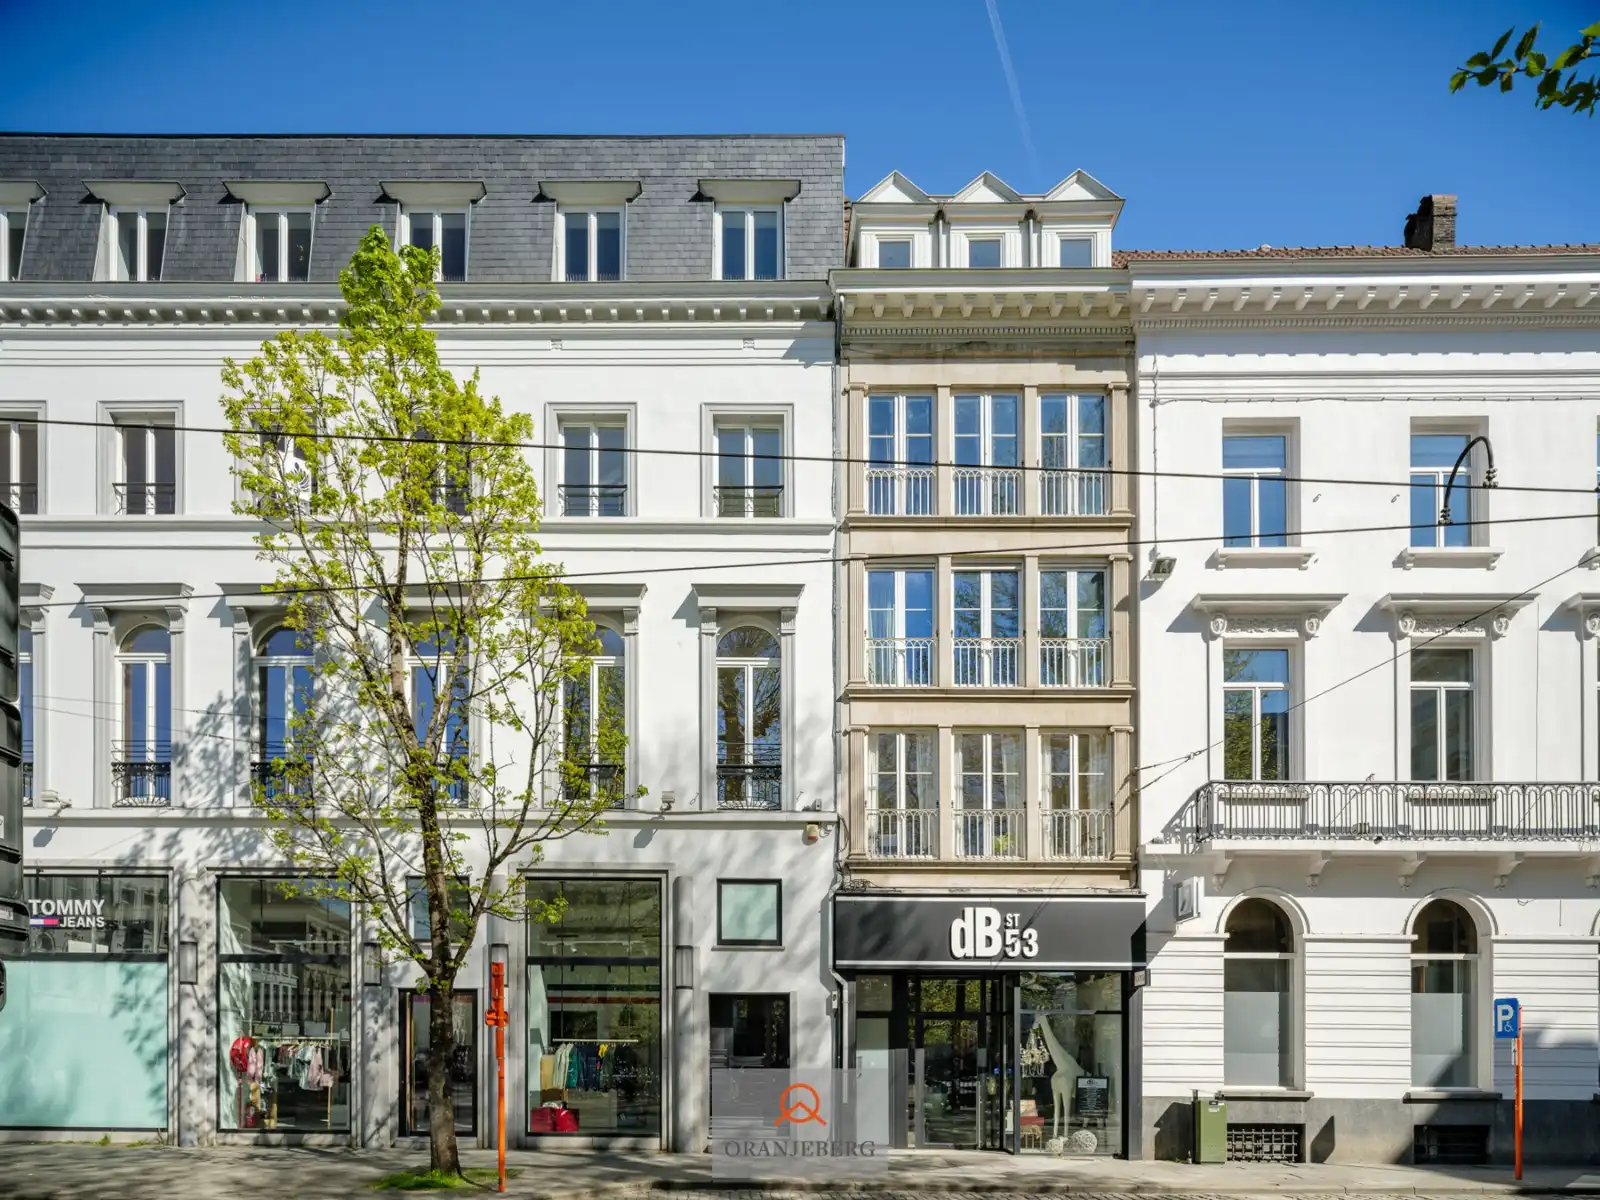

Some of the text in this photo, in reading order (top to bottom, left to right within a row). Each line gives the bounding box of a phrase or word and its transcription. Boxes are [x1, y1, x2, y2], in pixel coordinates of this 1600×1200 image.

[28, 899, 105, 916] TOMMY
[60, 916, 105, 928] JEANS
[1006, 913, 1020, 927] ST
[950, 907, 1002, 958] dB
[1005, 928, 1039, 957] 53
[1497, 1004, 1514, 1032] P
